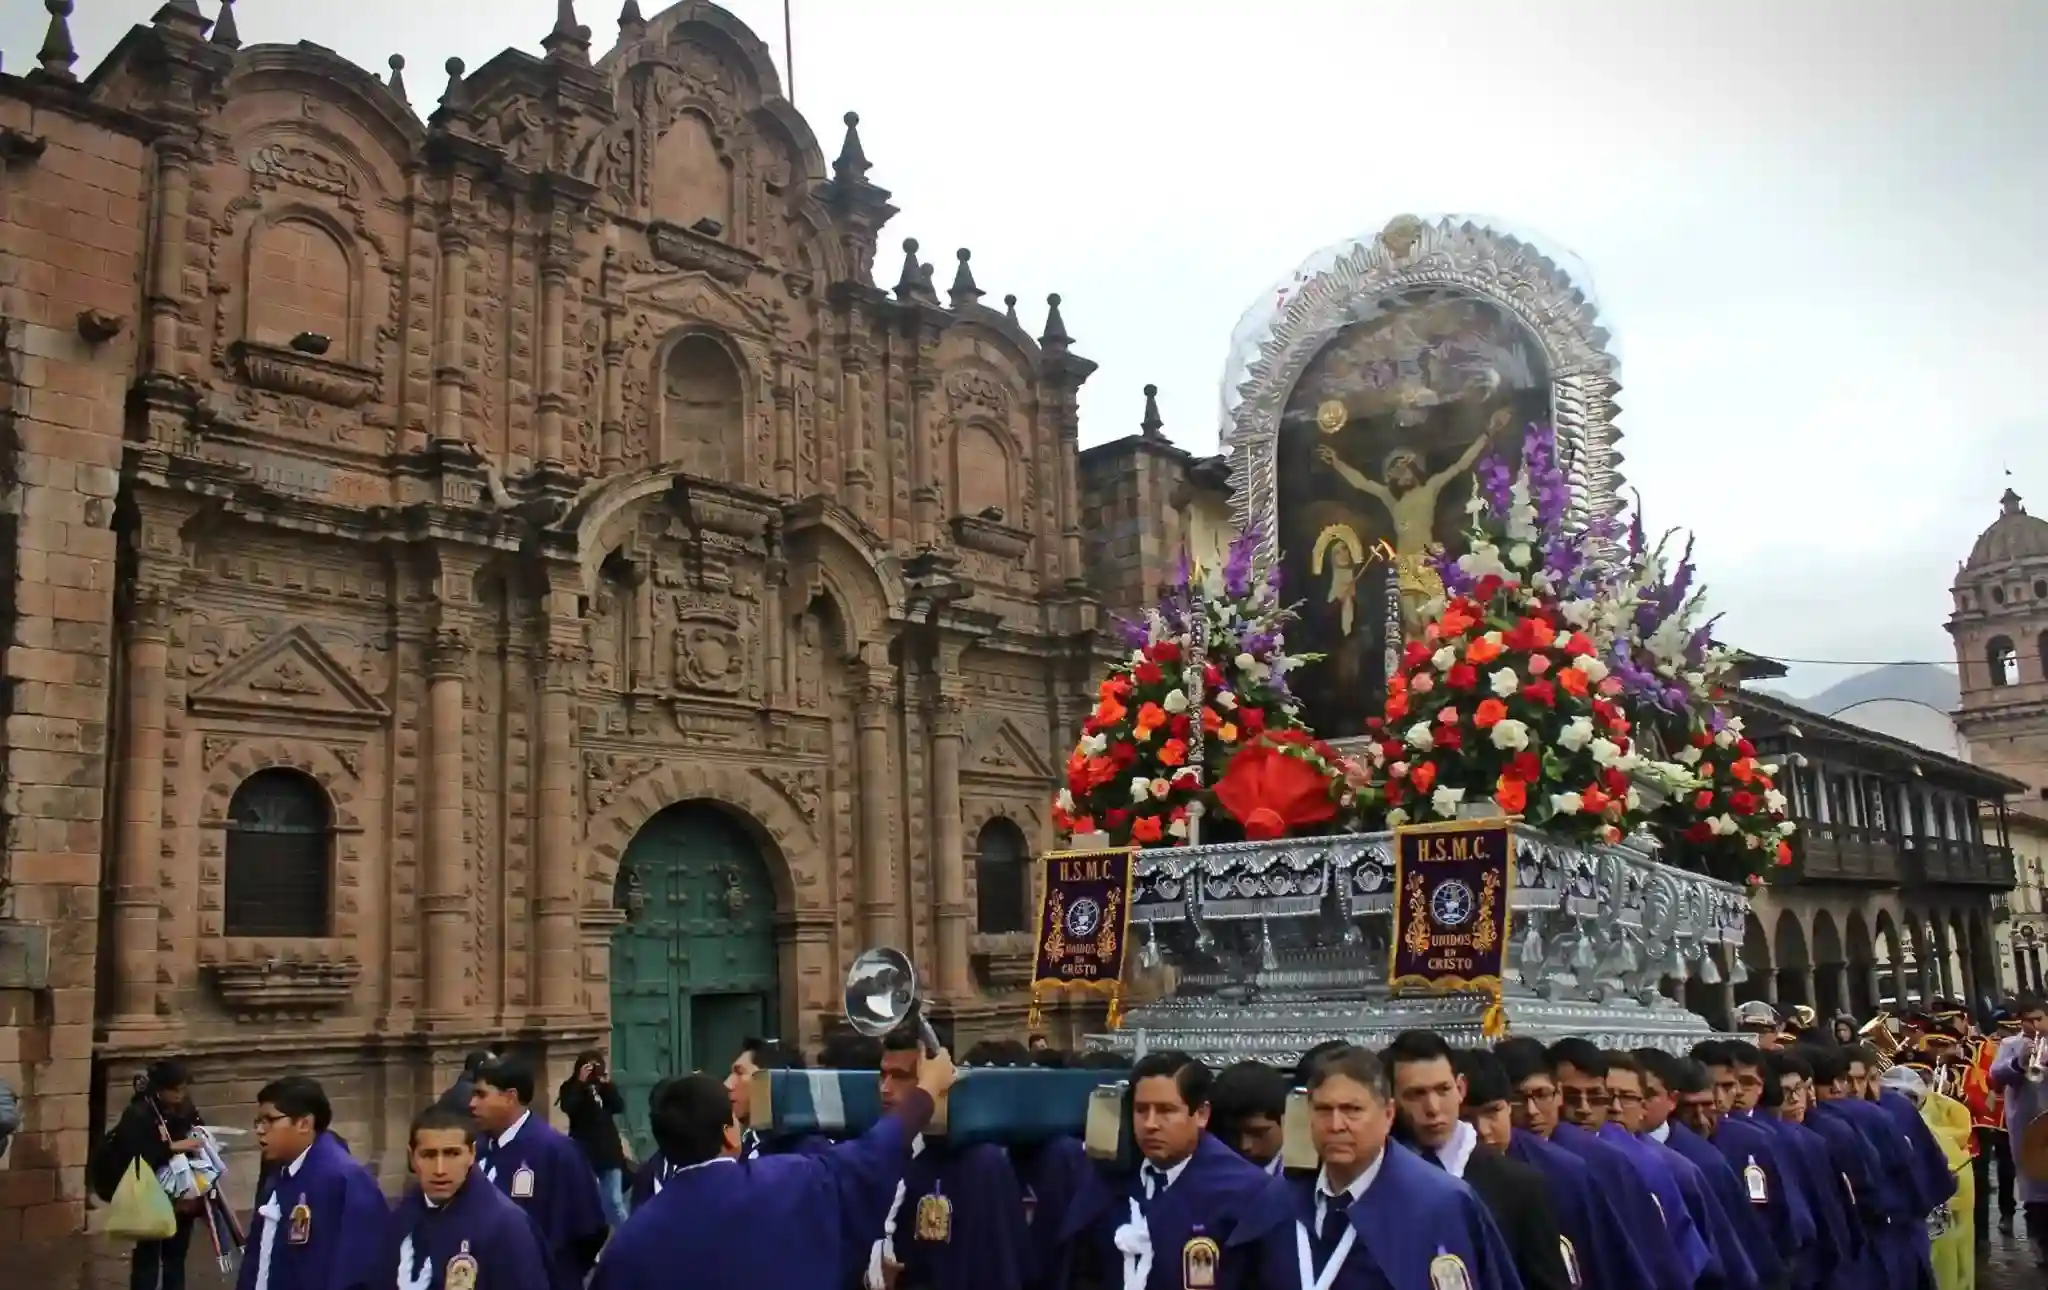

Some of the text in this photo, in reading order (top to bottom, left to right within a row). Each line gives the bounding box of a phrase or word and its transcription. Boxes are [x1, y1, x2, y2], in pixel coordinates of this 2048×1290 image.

[1418, 836, 1491, 862] H.S.M.C.
[1060, 860, 1115, 881] H.S.M.C.
[1431, 934, 1472, 946] UNIDOS
[1427, 957, 1473, 970] CRISTO
